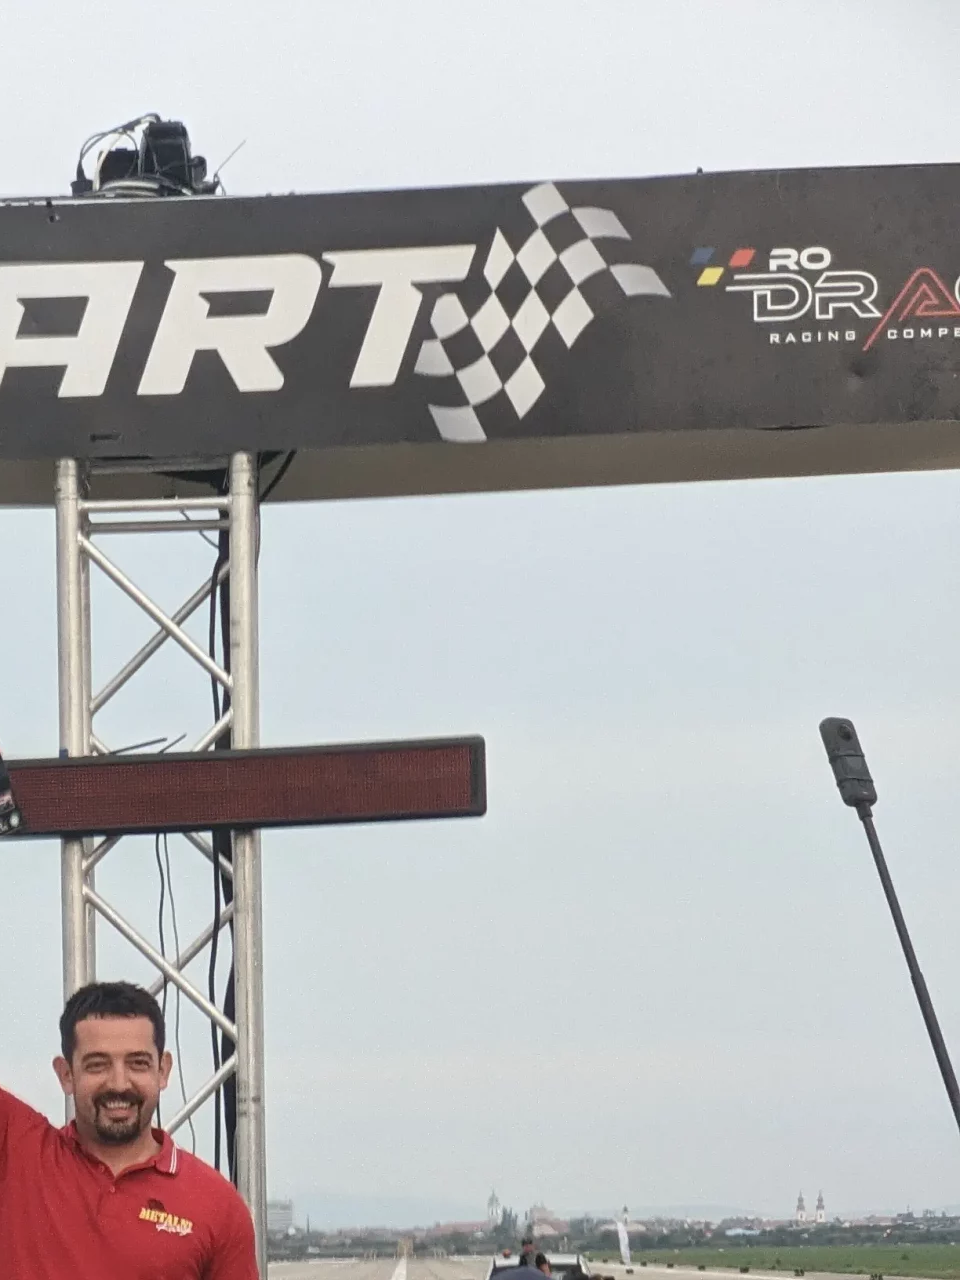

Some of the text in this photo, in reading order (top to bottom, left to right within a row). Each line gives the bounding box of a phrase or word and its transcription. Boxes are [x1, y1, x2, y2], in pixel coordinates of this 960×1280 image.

[769, 247, 831, 271] RO
[725, 267, 960, 351] DRA
[770, 330, 856, 344] RACING
